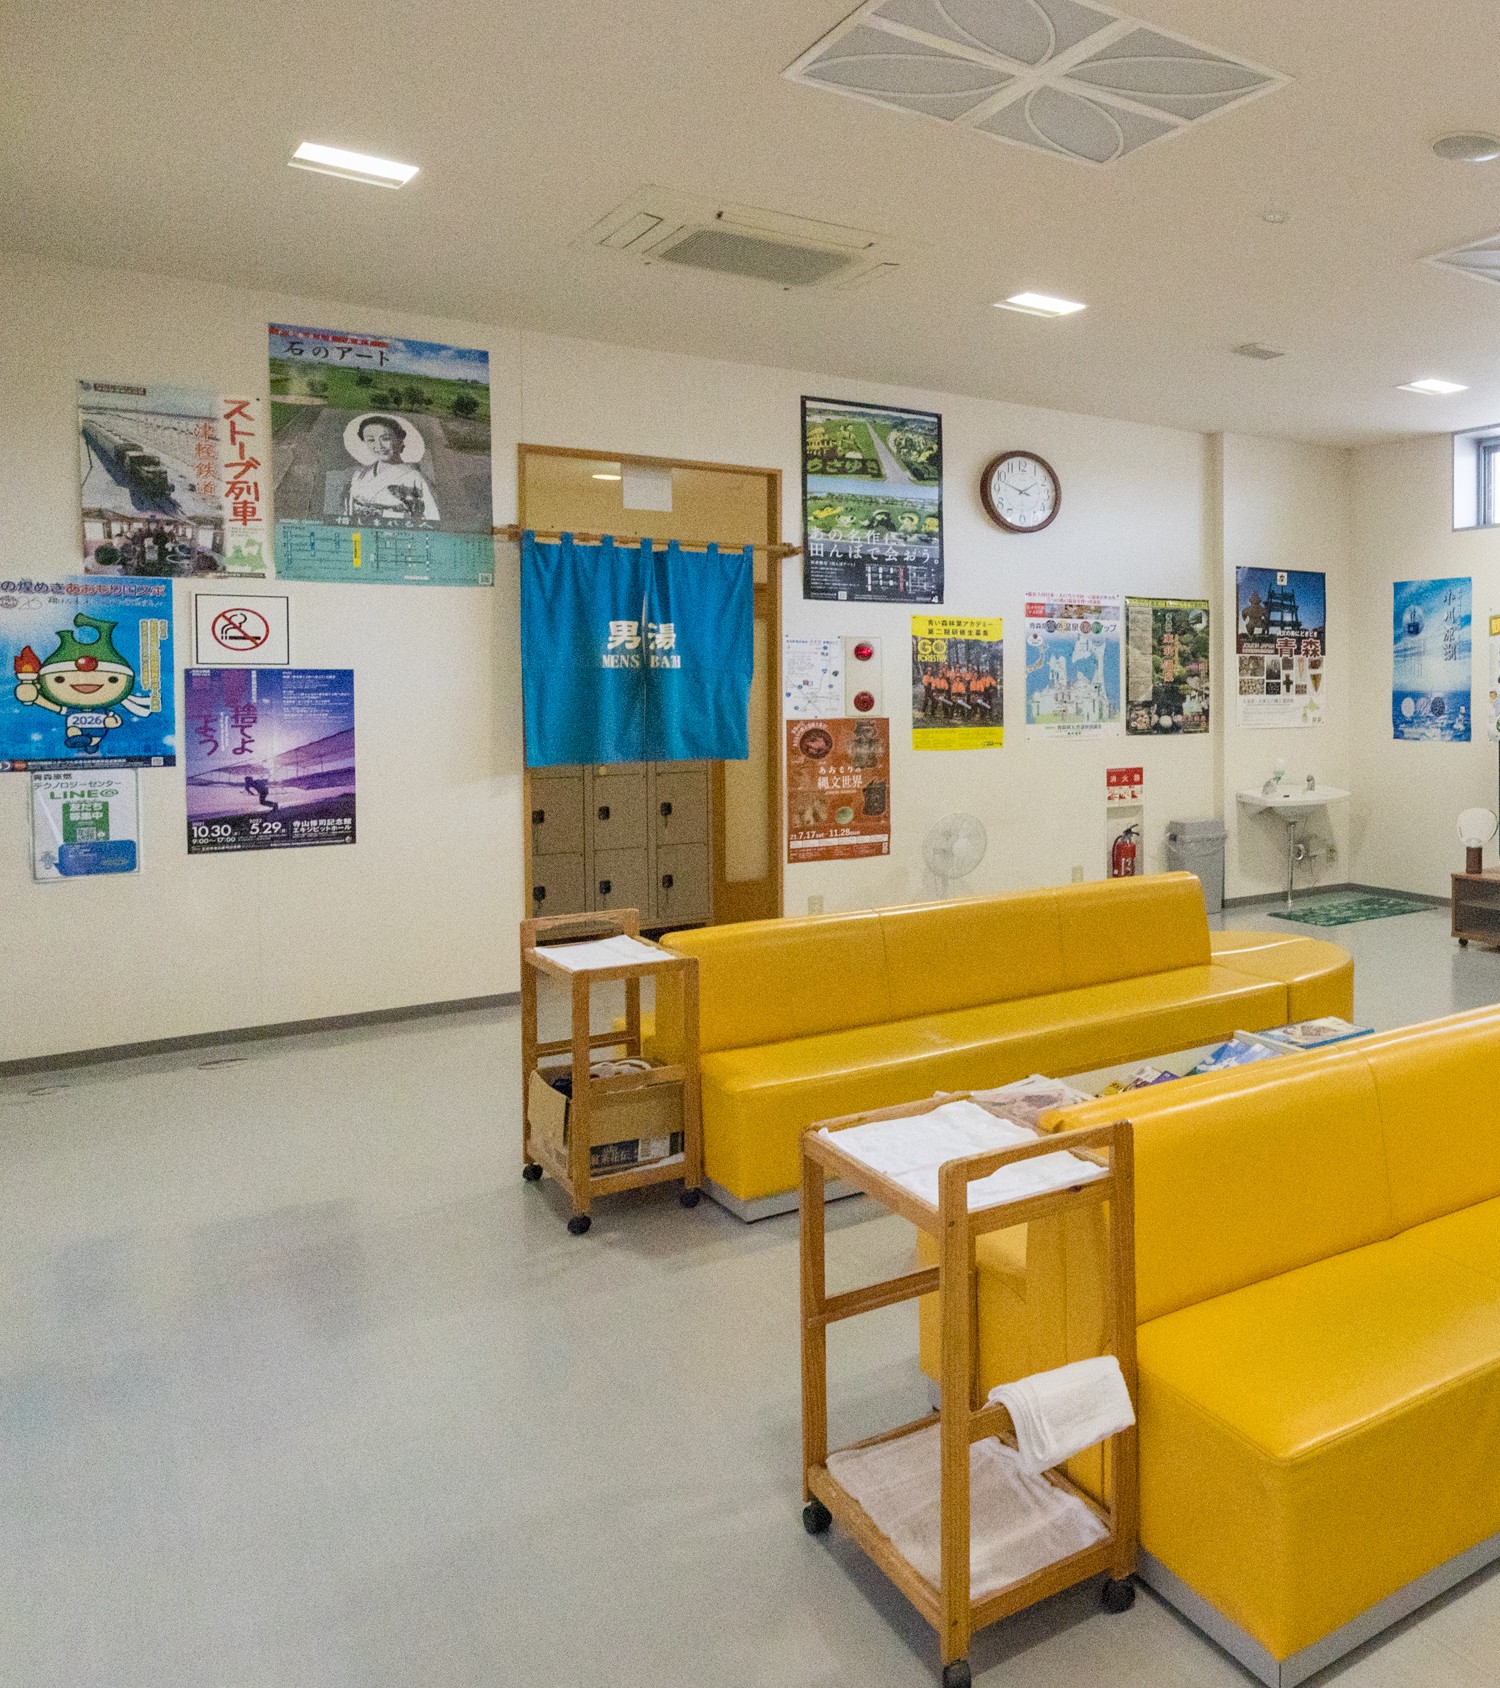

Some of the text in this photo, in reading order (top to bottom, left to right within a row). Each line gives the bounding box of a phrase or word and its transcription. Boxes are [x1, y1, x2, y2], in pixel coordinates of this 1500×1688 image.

[285, 340, 391, 367] 石のアート
[194, 421, 217, 497] 津軽鉄道
[222, 398, 264, 526] ストーブ列車
[810, 542, 939, 566] 田んぼで会おう。
[927, 618, 994, 628] 青い森林業アカデミー
[607, 620, 677, 650] 男湯
[917, 639, 947, 655] GO
[1275, 637, 1322, 659] 青森
[602, 654, 640, 669] MENS
[71, 715, 103, 726] 2026
[34, 779, 122, 791] テクノロジーセンター
[817, 774, 864, 790] 縄文世界
[1109, 774, 1141, 783] 消火器
[191, 823, 232, 839] 10.30
[250, 822, 282, 835] 5.29
[828, 828, 850, 838] 11.28
